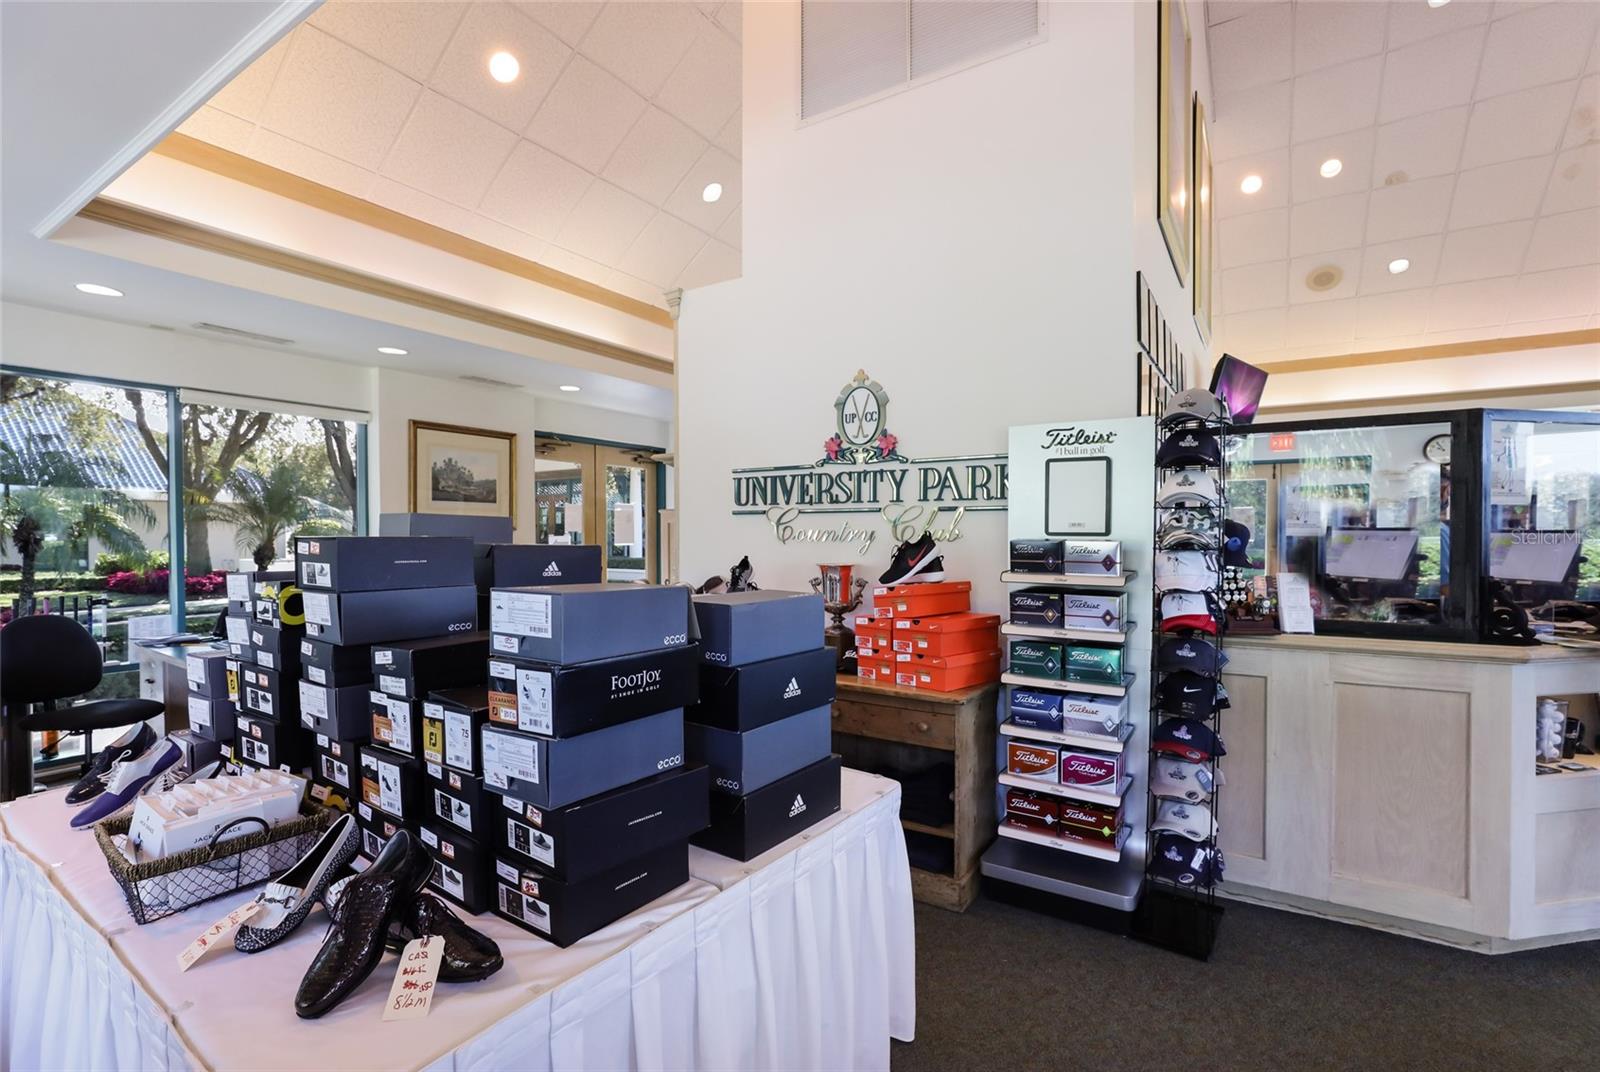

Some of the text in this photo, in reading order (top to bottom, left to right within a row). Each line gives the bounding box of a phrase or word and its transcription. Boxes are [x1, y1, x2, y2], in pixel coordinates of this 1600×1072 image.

[844, 411, 878, 424] UP CC
[1041, 427, 1117, 449] Titleist
[1063, 446, 1079, 456] ball
[1080, 447, 1088, 455] in
[1090, 445, 1105, 457] golf
[732, 463, 1008, 506] UNIVERSITY PARK
[765, 507, 876, 553] Country
[1069, 545, 1101, 555] Titleist
[1013, 596, 1044, 607] Titleist
[1068, 599, 1101, 610] Titleist
[448, 622, 472, 632] ecco
[664, 634, 686, 645] ecco
[705, 651, 727, 662] ecco
[1013, 646, 1044, 657] Titleist
[1069, 651, 1102, 661] Titleist
[541, 687, 546, 698] 7
[783, 688, 801, 699] adidas
[1014, 693, 1045, 705] Titleist
[1067, 703, 1099, 715] Titleist
[429, 731, 437, 748] FJ
[657, 754, 681, 769] ecco
[1014, 750, 1049, 765] Titleist
[1068, 760, 1107, 775] Titleist
[716, 777, 739, 790] ecco
[789, 804, 806, 817] adidas
[1009, 798, 1040, 811] Titleist
[1064, 808, 1097, 823] Titleist
